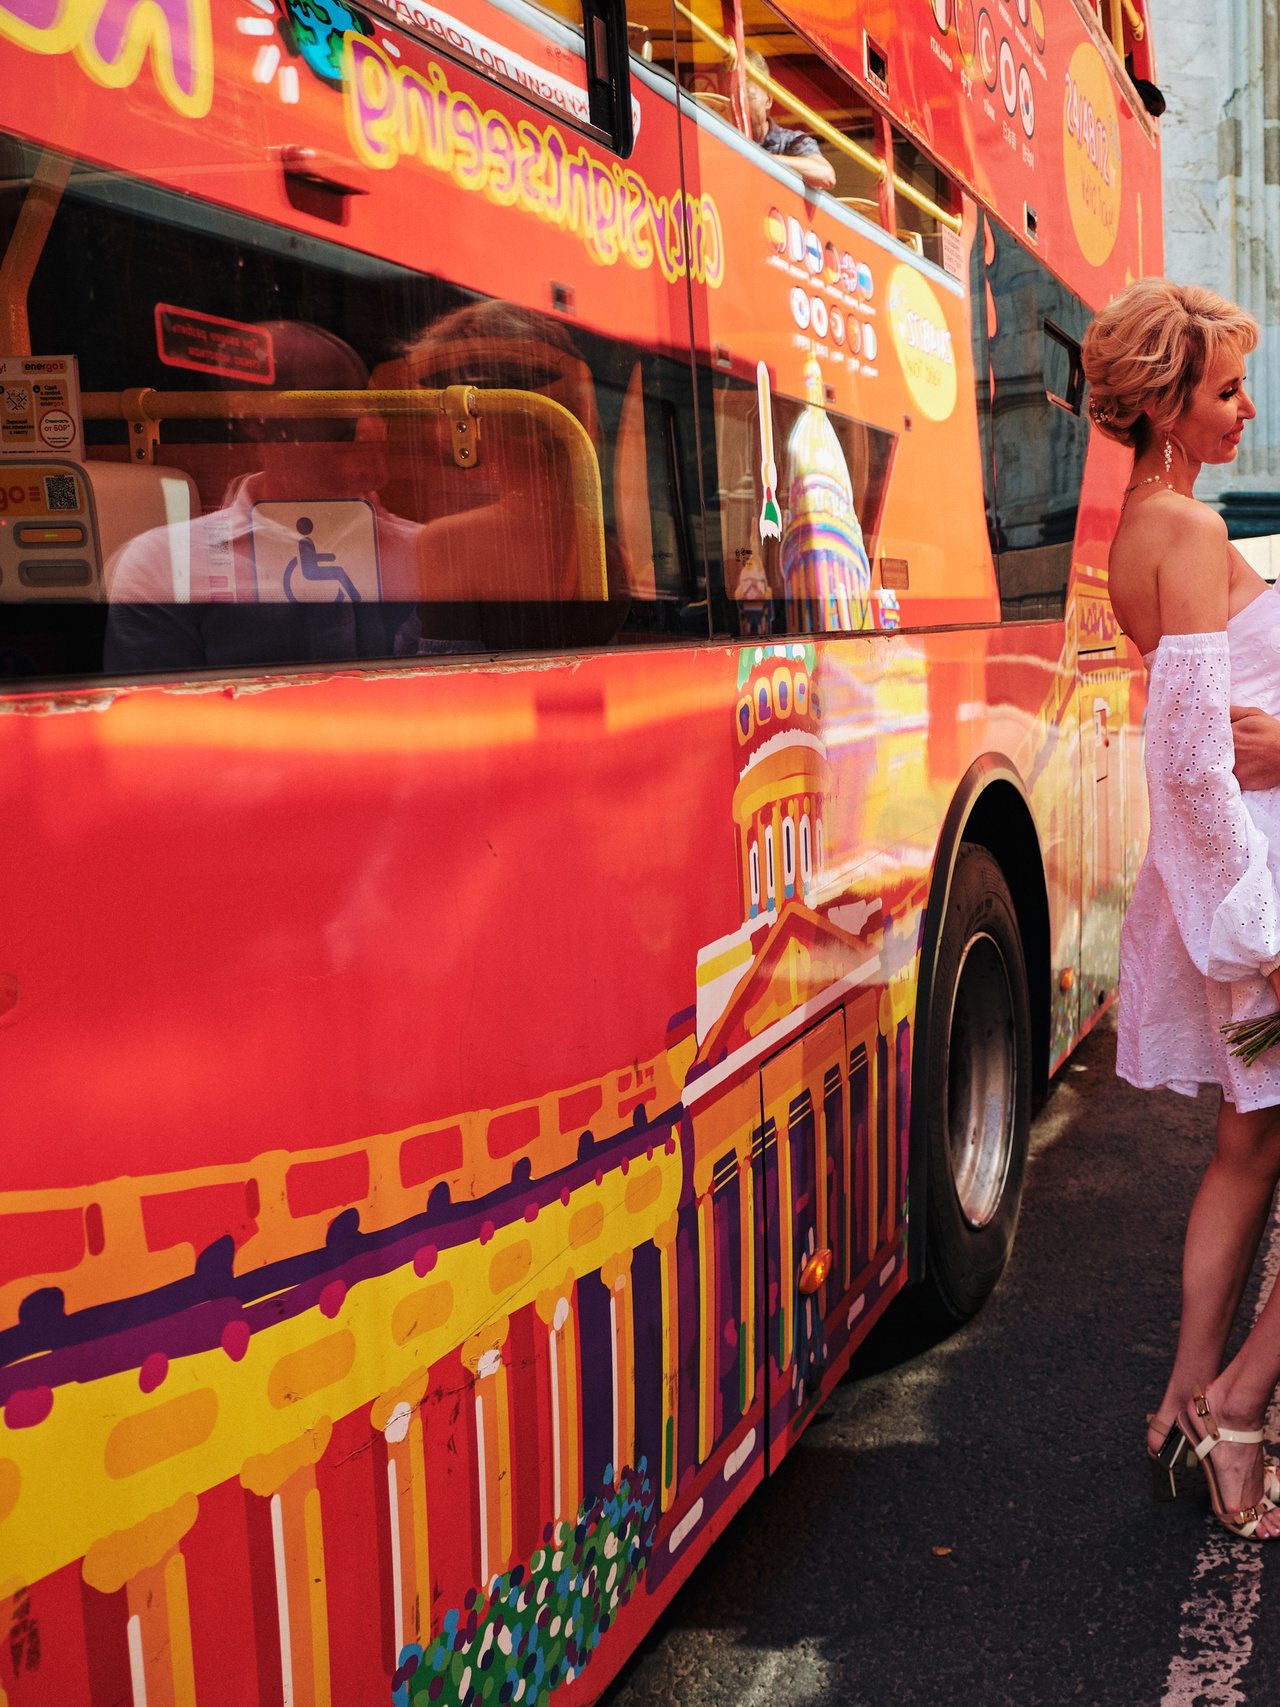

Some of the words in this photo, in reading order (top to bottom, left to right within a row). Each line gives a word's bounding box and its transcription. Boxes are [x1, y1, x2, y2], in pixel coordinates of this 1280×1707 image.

[930, 35, 953, 73] ITALIANO
[960, 69, 974, 102] 中文
[24, 362, 58, 373] energo
